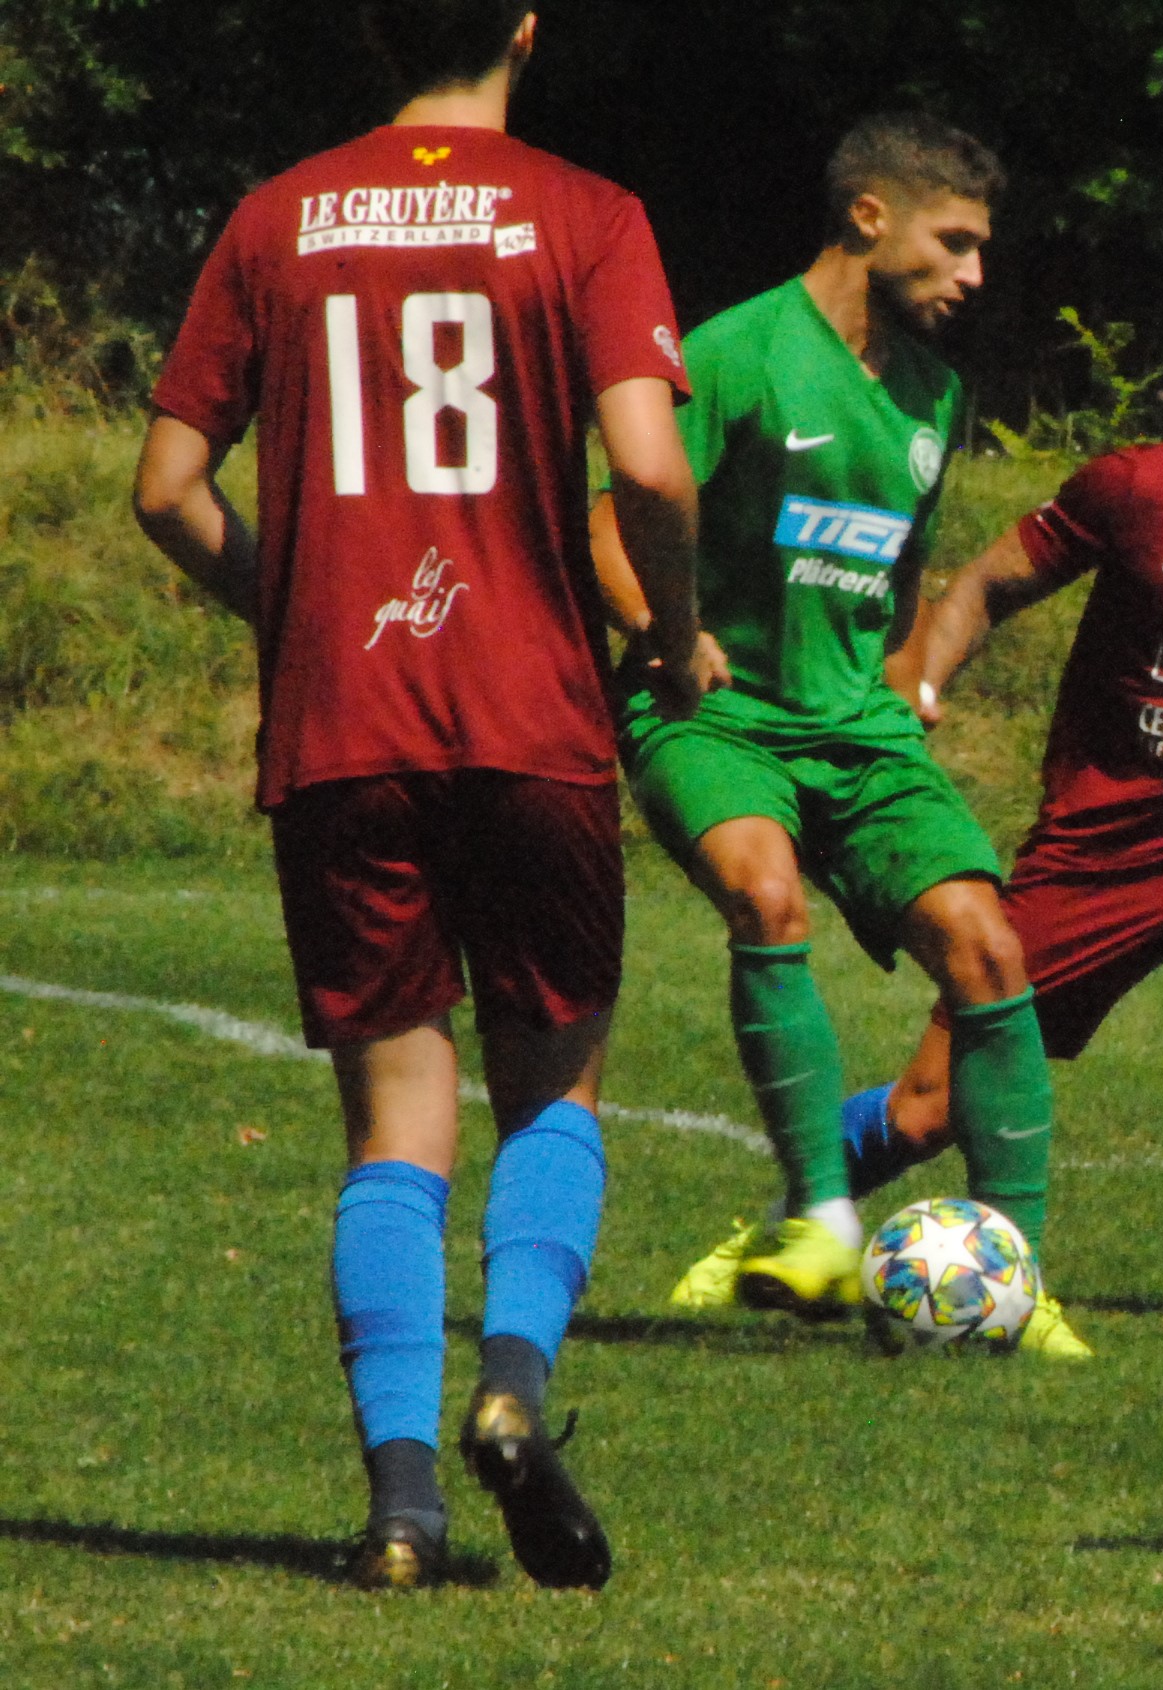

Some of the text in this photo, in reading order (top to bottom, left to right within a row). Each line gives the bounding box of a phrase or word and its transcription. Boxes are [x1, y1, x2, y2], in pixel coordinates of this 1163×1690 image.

[300, 192, 338, 233] LE
[306, 227, 482, 249] SWITZERLAND
[325, 292, 498, 496] 18
